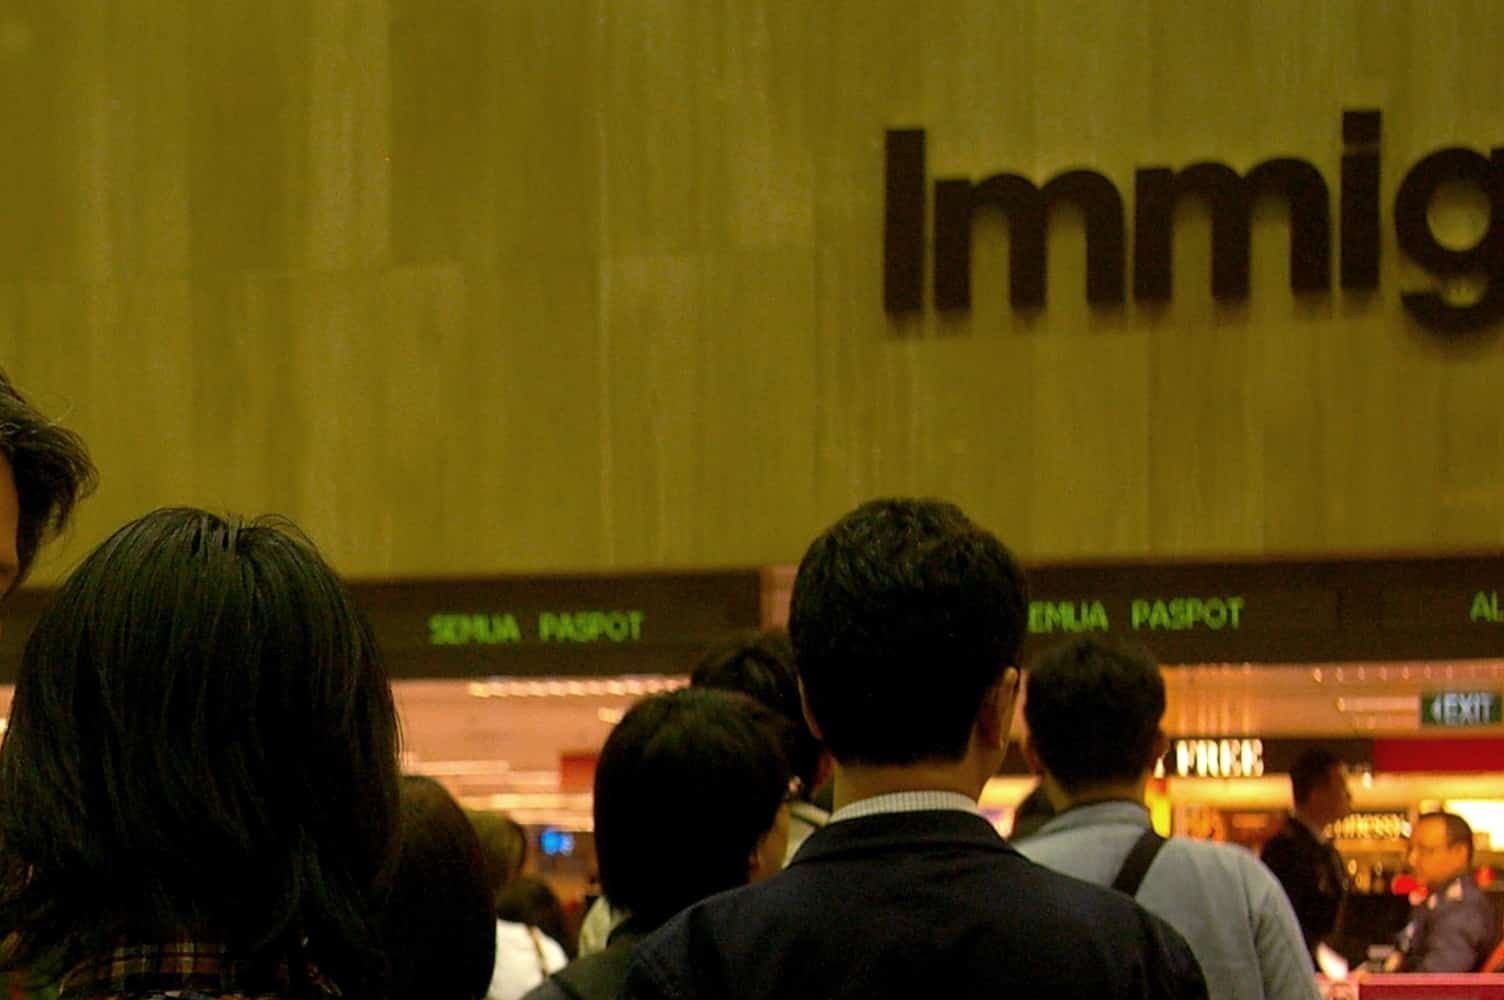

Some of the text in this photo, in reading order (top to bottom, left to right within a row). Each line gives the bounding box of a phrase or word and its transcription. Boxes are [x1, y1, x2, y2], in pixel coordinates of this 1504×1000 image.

[539, 610, 644, 641] PASPOT
[1026, 597, 1244, 633] EMUA PASPOT
[1444, 692, 1494, 726] EXIT
[1176, 739, 1264, 777] FREE
